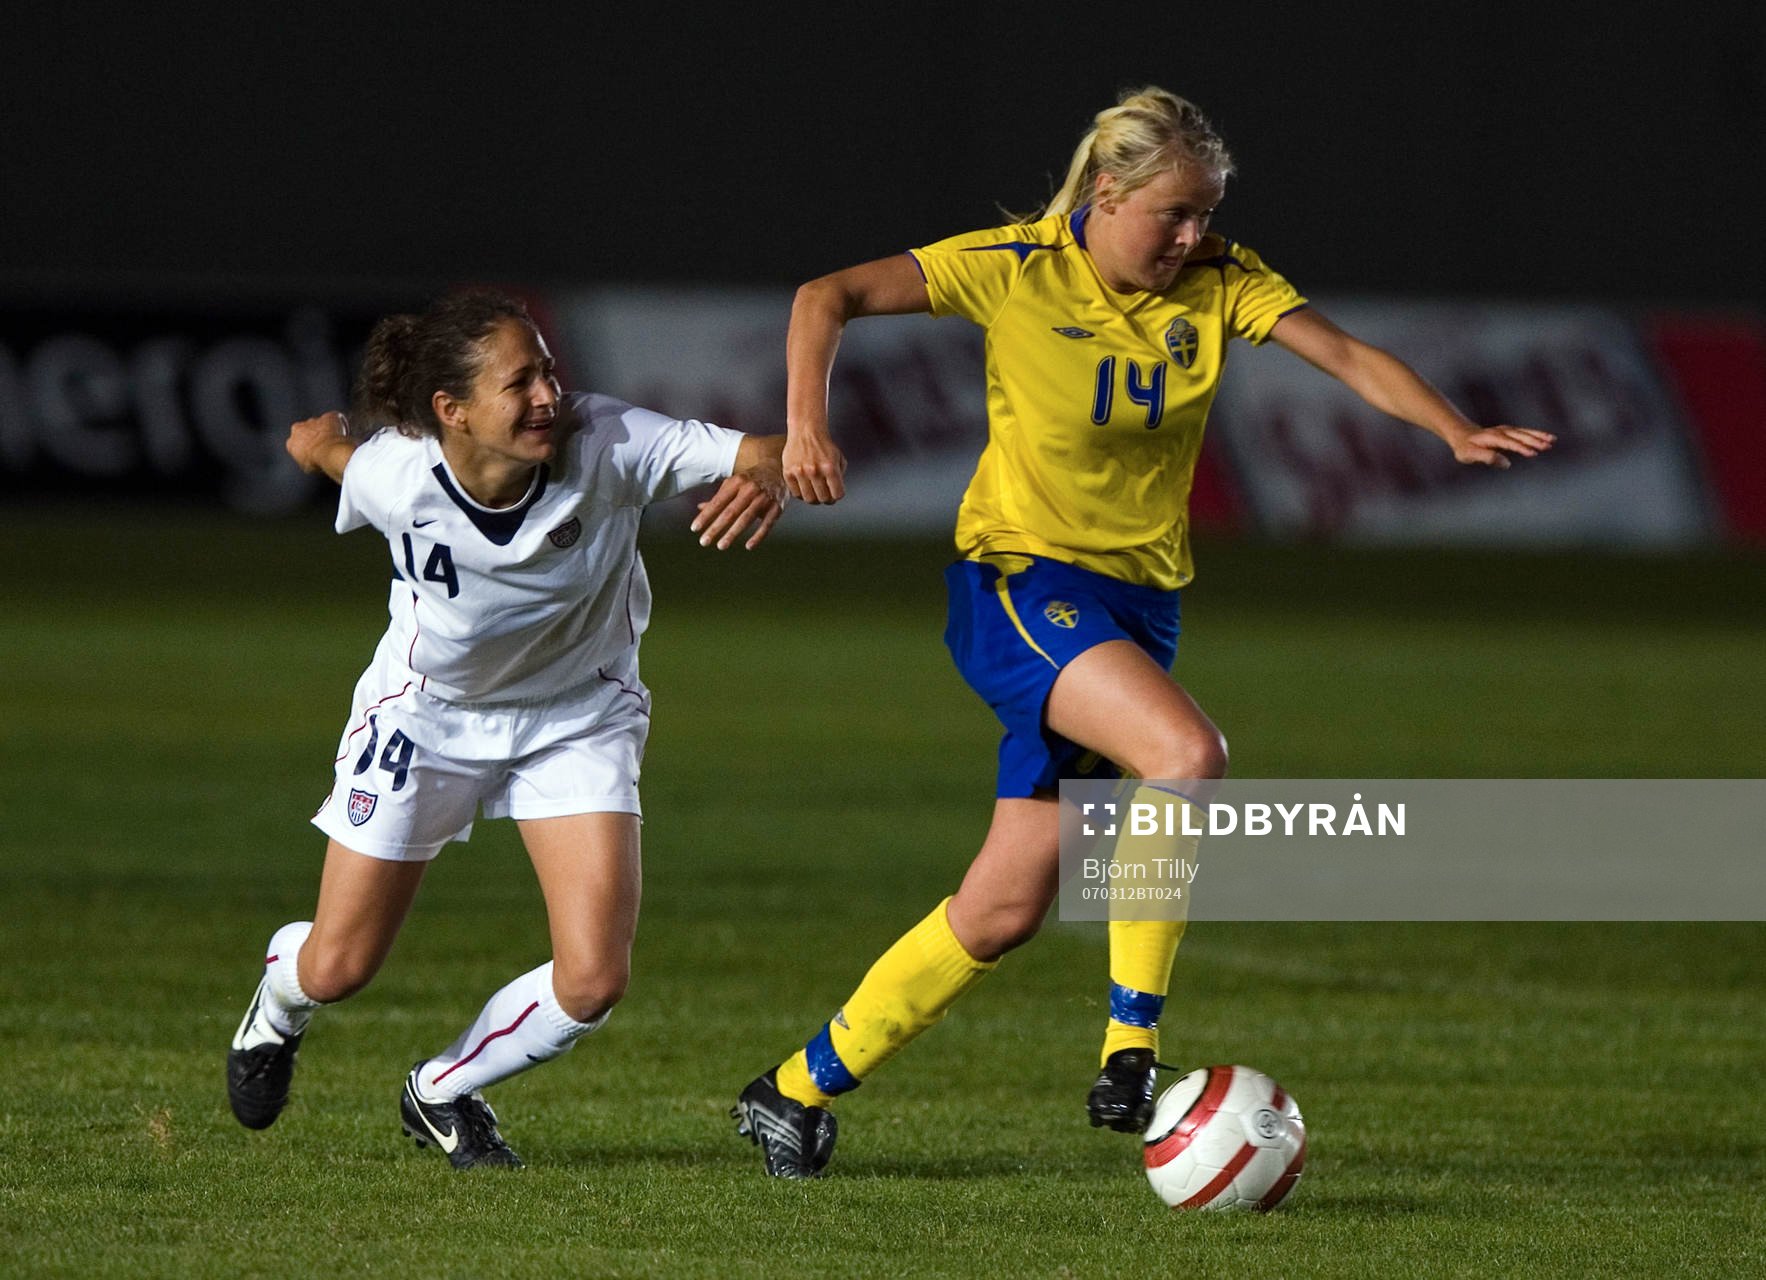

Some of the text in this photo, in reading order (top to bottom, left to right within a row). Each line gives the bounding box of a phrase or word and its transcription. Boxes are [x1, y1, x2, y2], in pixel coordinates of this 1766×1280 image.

[1091, 355, 1167, 430] 14
[402, 532, 460, 599] 14
[353, 713, 415, 792] 14
